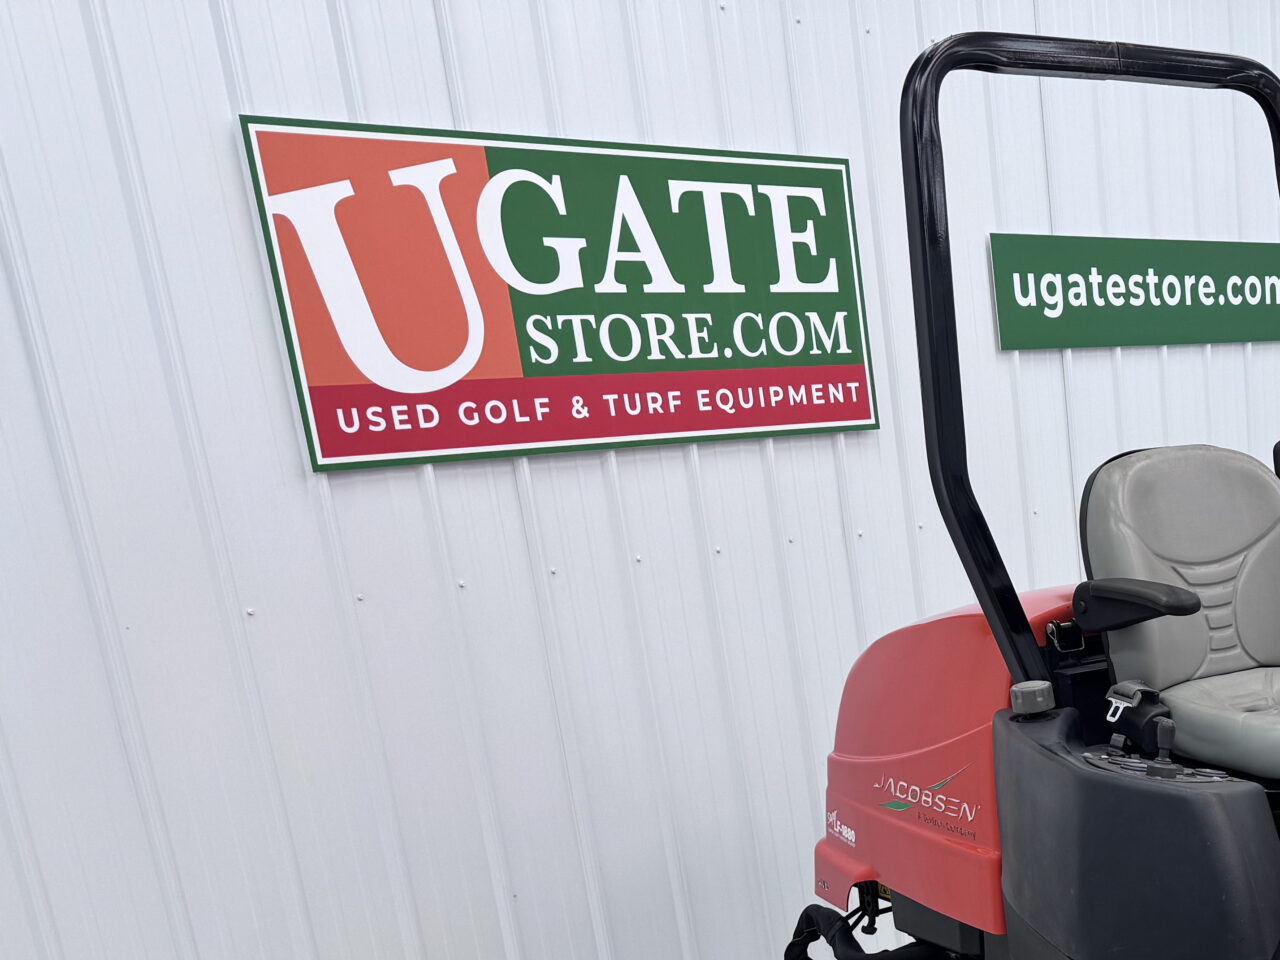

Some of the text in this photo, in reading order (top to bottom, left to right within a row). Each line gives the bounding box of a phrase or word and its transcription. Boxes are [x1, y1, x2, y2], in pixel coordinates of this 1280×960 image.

[525, 311, 853, 365] STORE.COM
[336, 382, 861, 434] USED GOLF & TURF EQUIPMENT
[872, 771, 977, 822] JACOBSEN
